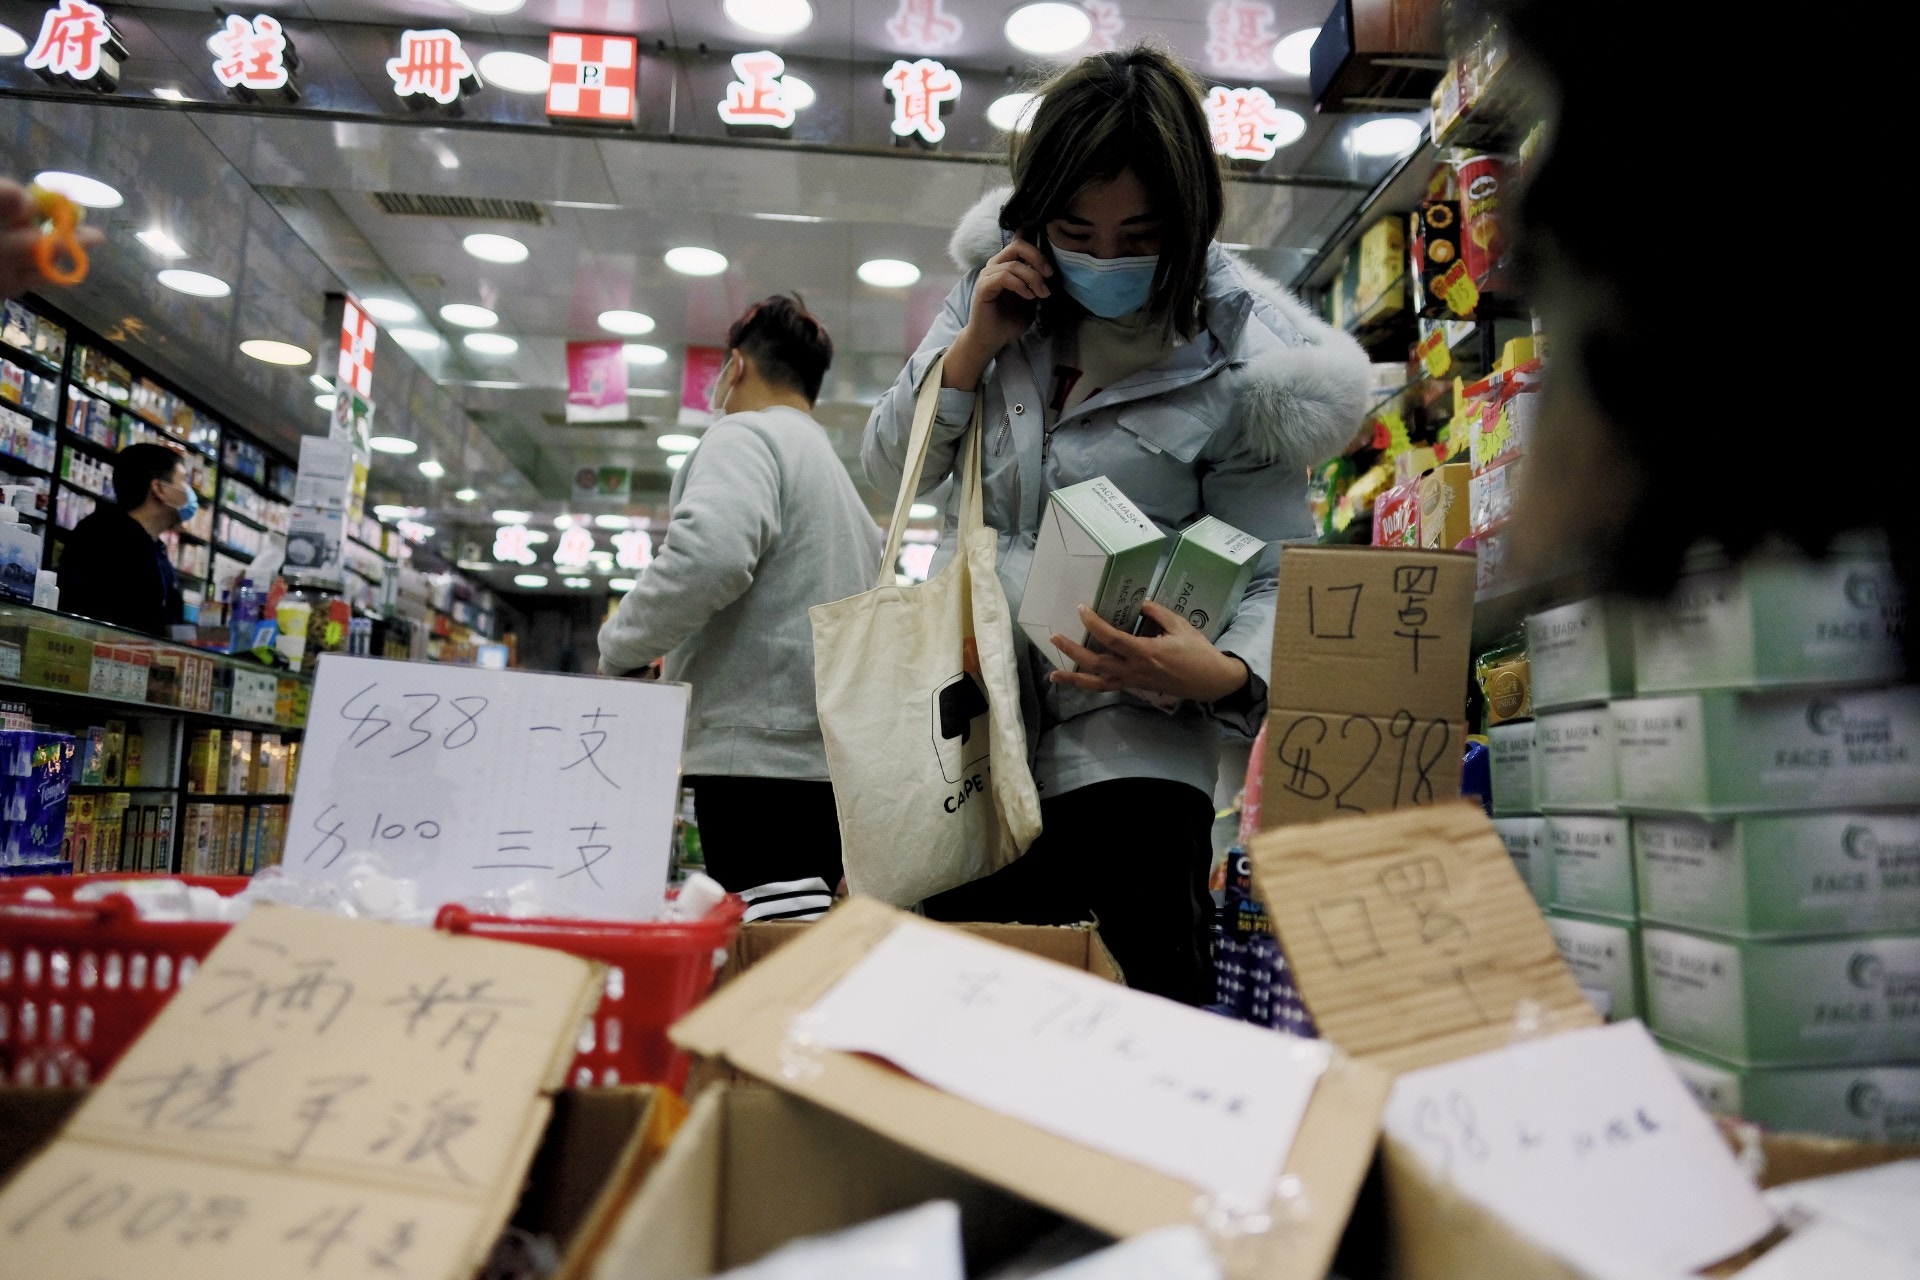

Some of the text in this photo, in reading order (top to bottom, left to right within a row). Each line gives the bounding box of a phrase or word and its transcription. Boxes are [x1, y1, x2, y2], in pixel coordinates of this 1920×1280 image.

[1096, 482, 1140, 523] FACE MASK
[1174, 582, 1194, 613] FACE
[1278, 709, 1450, 814] $298
[943, 774, 984, 814] CAPE
[472, 821, 612, 891] 三支
